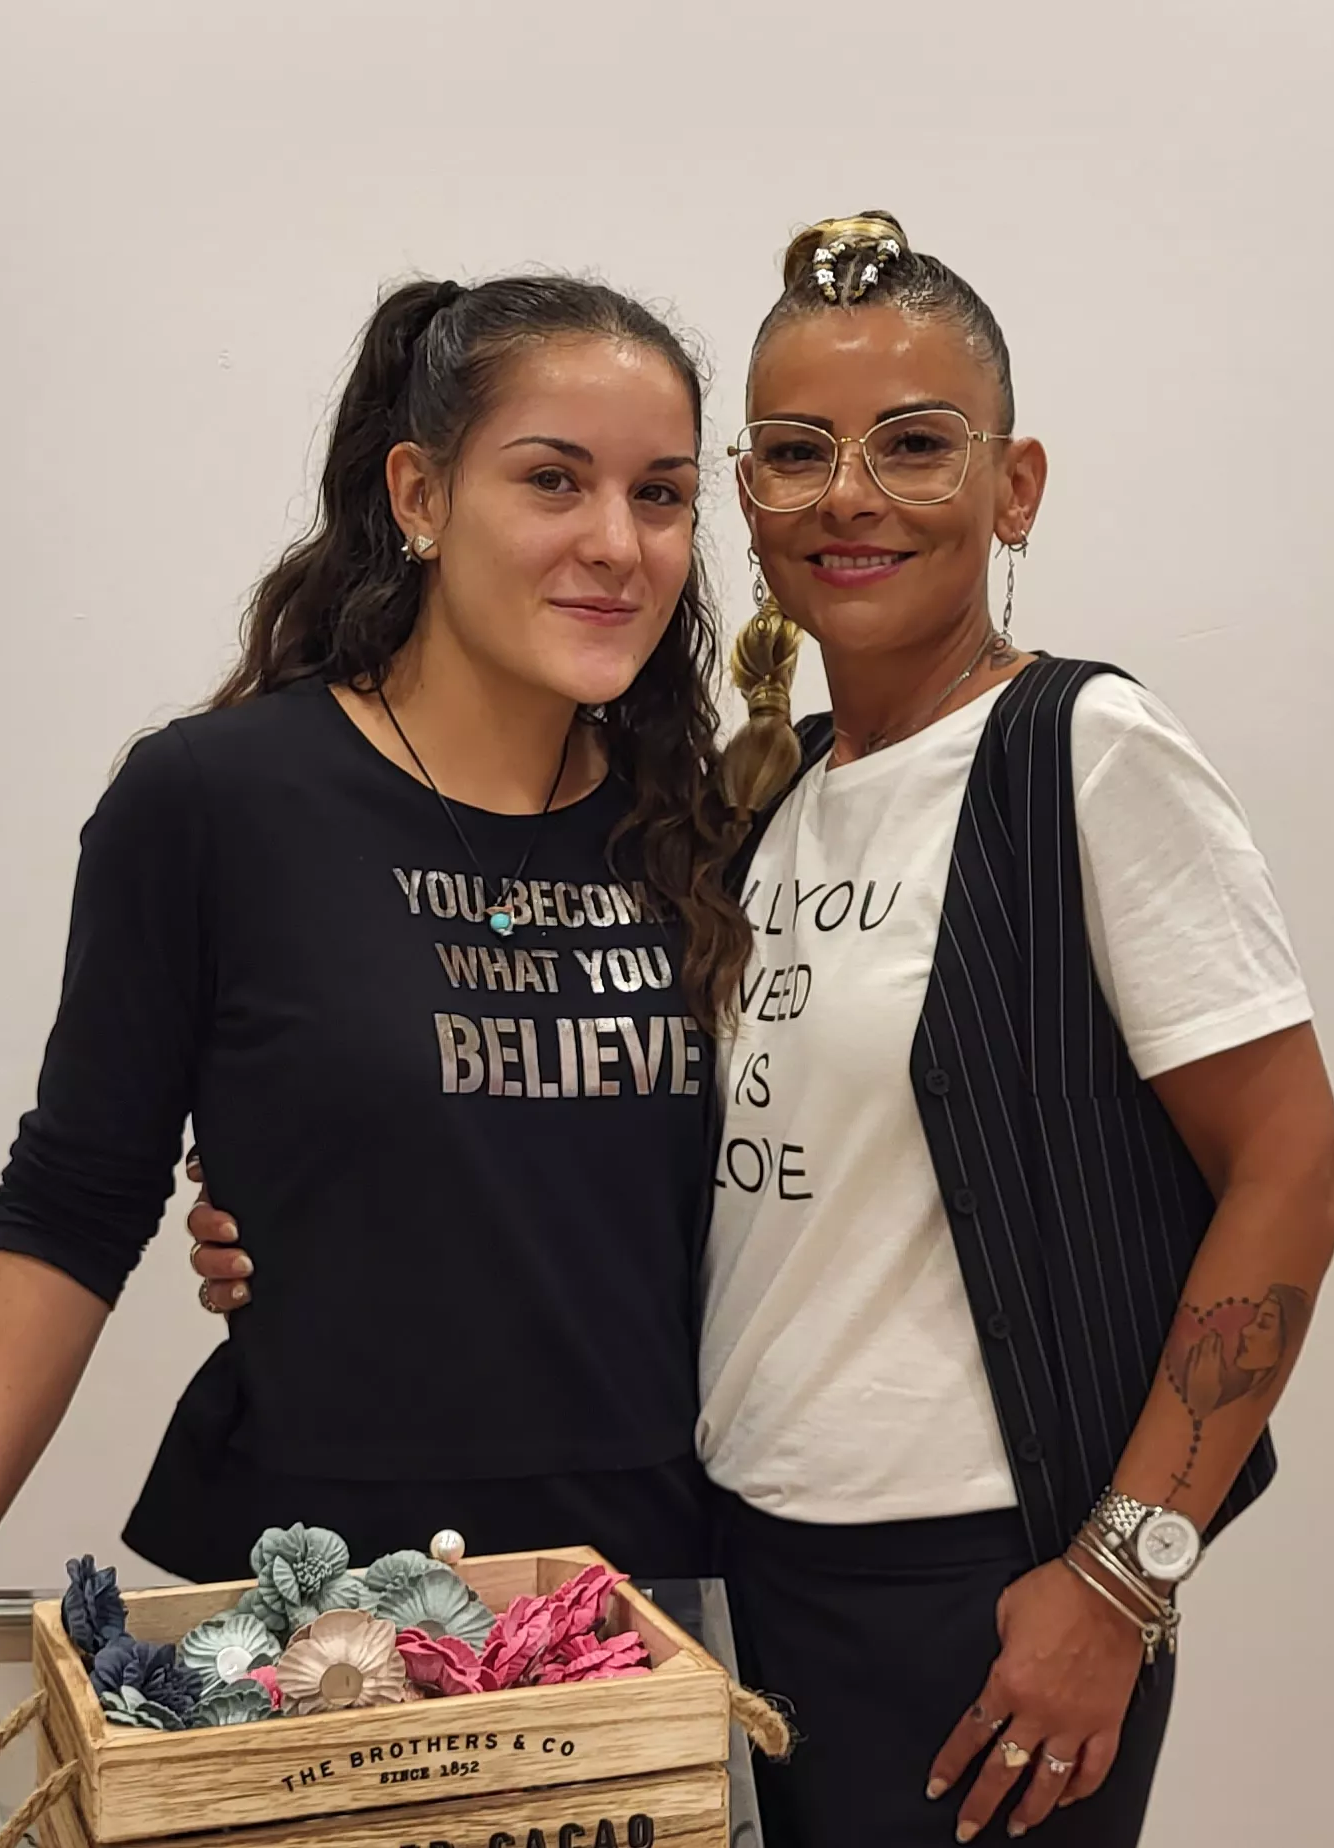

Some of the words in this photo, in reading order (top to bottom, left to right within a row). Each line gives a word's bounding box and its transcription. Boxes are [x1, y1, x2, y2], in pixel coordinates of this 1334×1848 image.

[392, 867, 486, 923] YOU
[434, 942, 560, 993] WHAT
[572, 945, 674, 994] YOU
[433, 1011, 701, 1098] BELIEVE
[735, 1052, 771, 1109] IS
[281, 1760, 336, 1793] THE
[350, 1733, 499, 1769] BROTHERS
[513, 1734, 526, 1751] &
[542, 1737, 576, 1757] CO
[380, 1766, 431, 1785] SINCE
[440, 1760, 481, 1779] 1852
